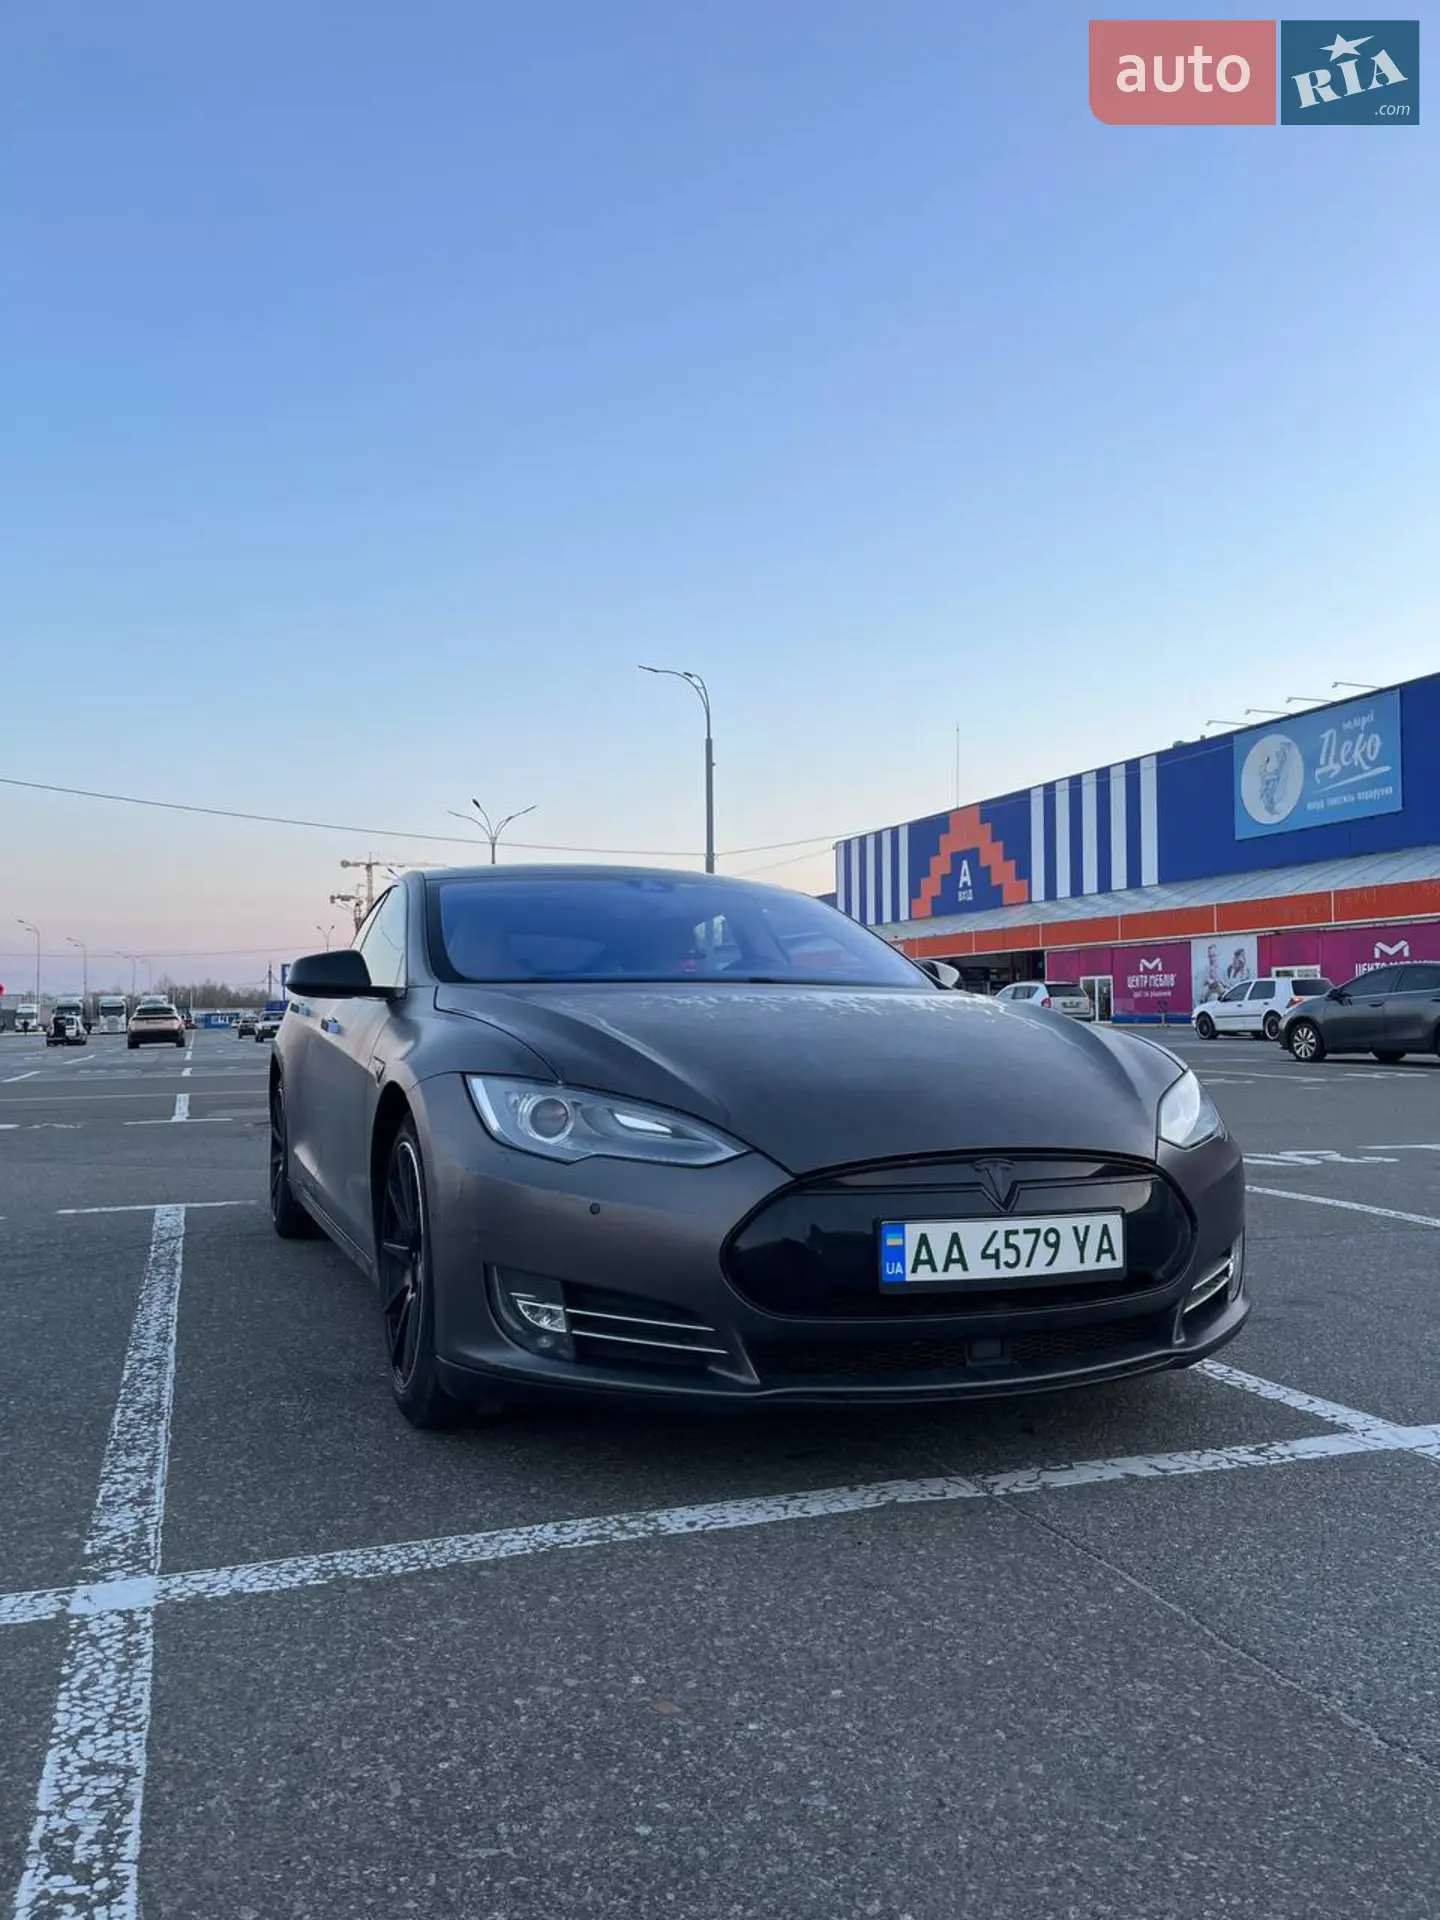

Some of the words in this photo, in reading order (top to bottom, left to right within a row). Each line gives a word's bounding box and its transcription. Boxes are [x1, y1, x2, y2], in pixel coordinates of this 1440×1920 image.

[1314, 728, 1382, 784] Деко
[886, 1262, 903, 1275] UA
[910, 1232, 968, 1274] AA
[980, 1227, 1061, 1270] 4579
[1072, 1223, 1117, 1264] YA
